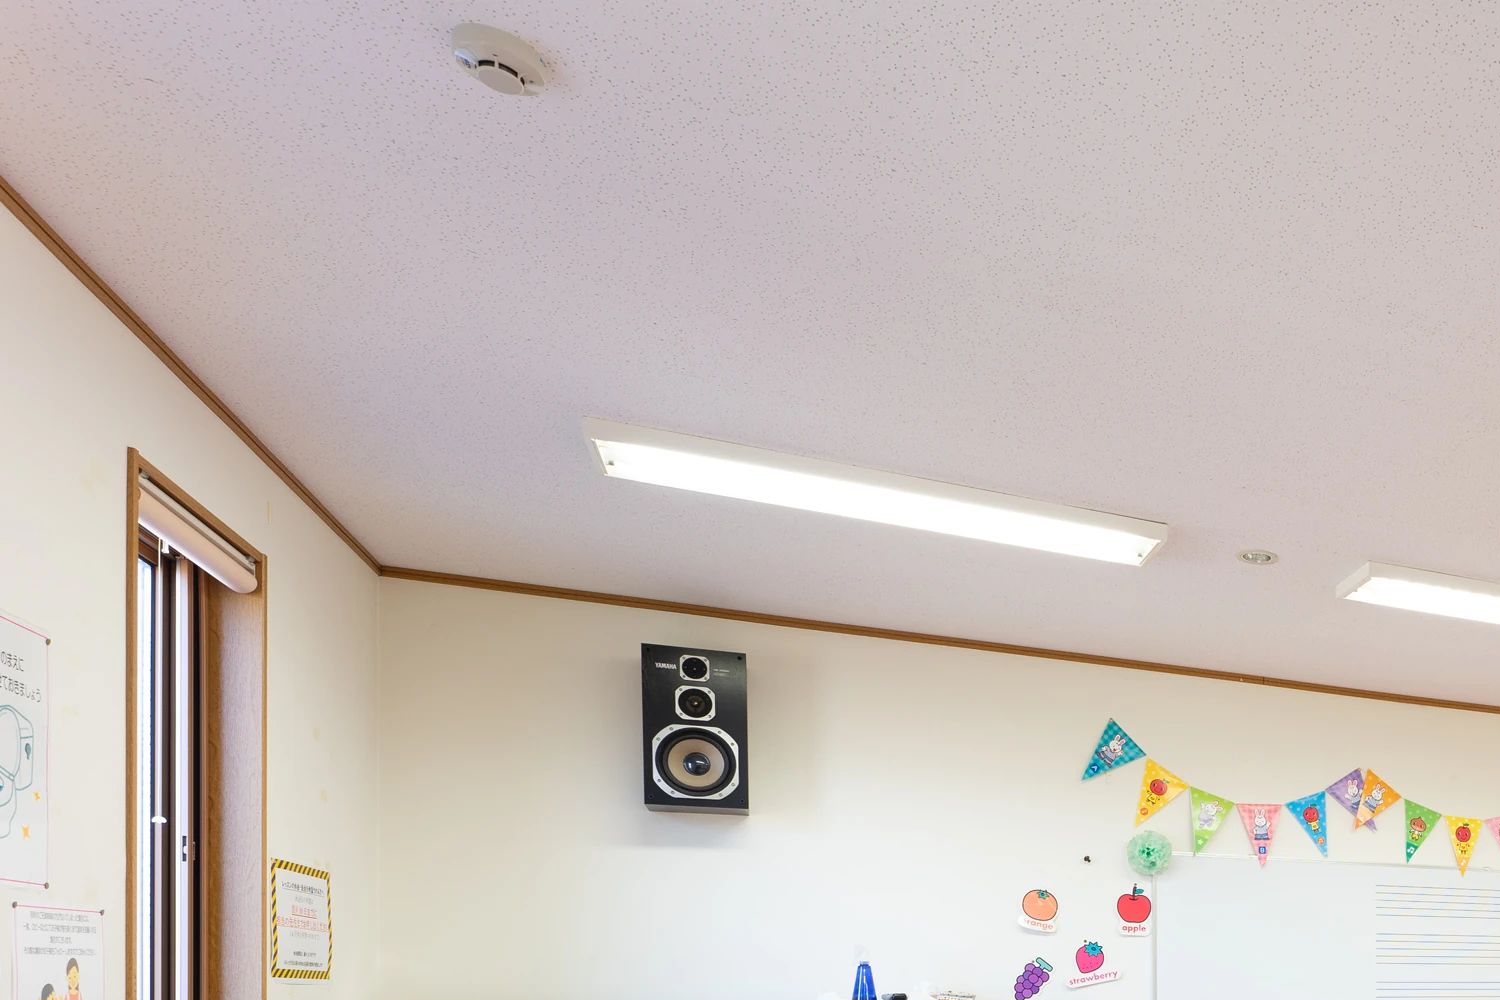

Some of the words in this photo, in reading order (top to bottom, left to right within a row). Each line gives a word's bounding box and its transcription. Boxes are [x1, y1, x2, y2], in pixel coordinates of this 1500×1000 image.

[1024, 919, 1054, 930] range
[1122, 924, 1146, 934] apple
[1069, 970, 1118, 986] strawberry
